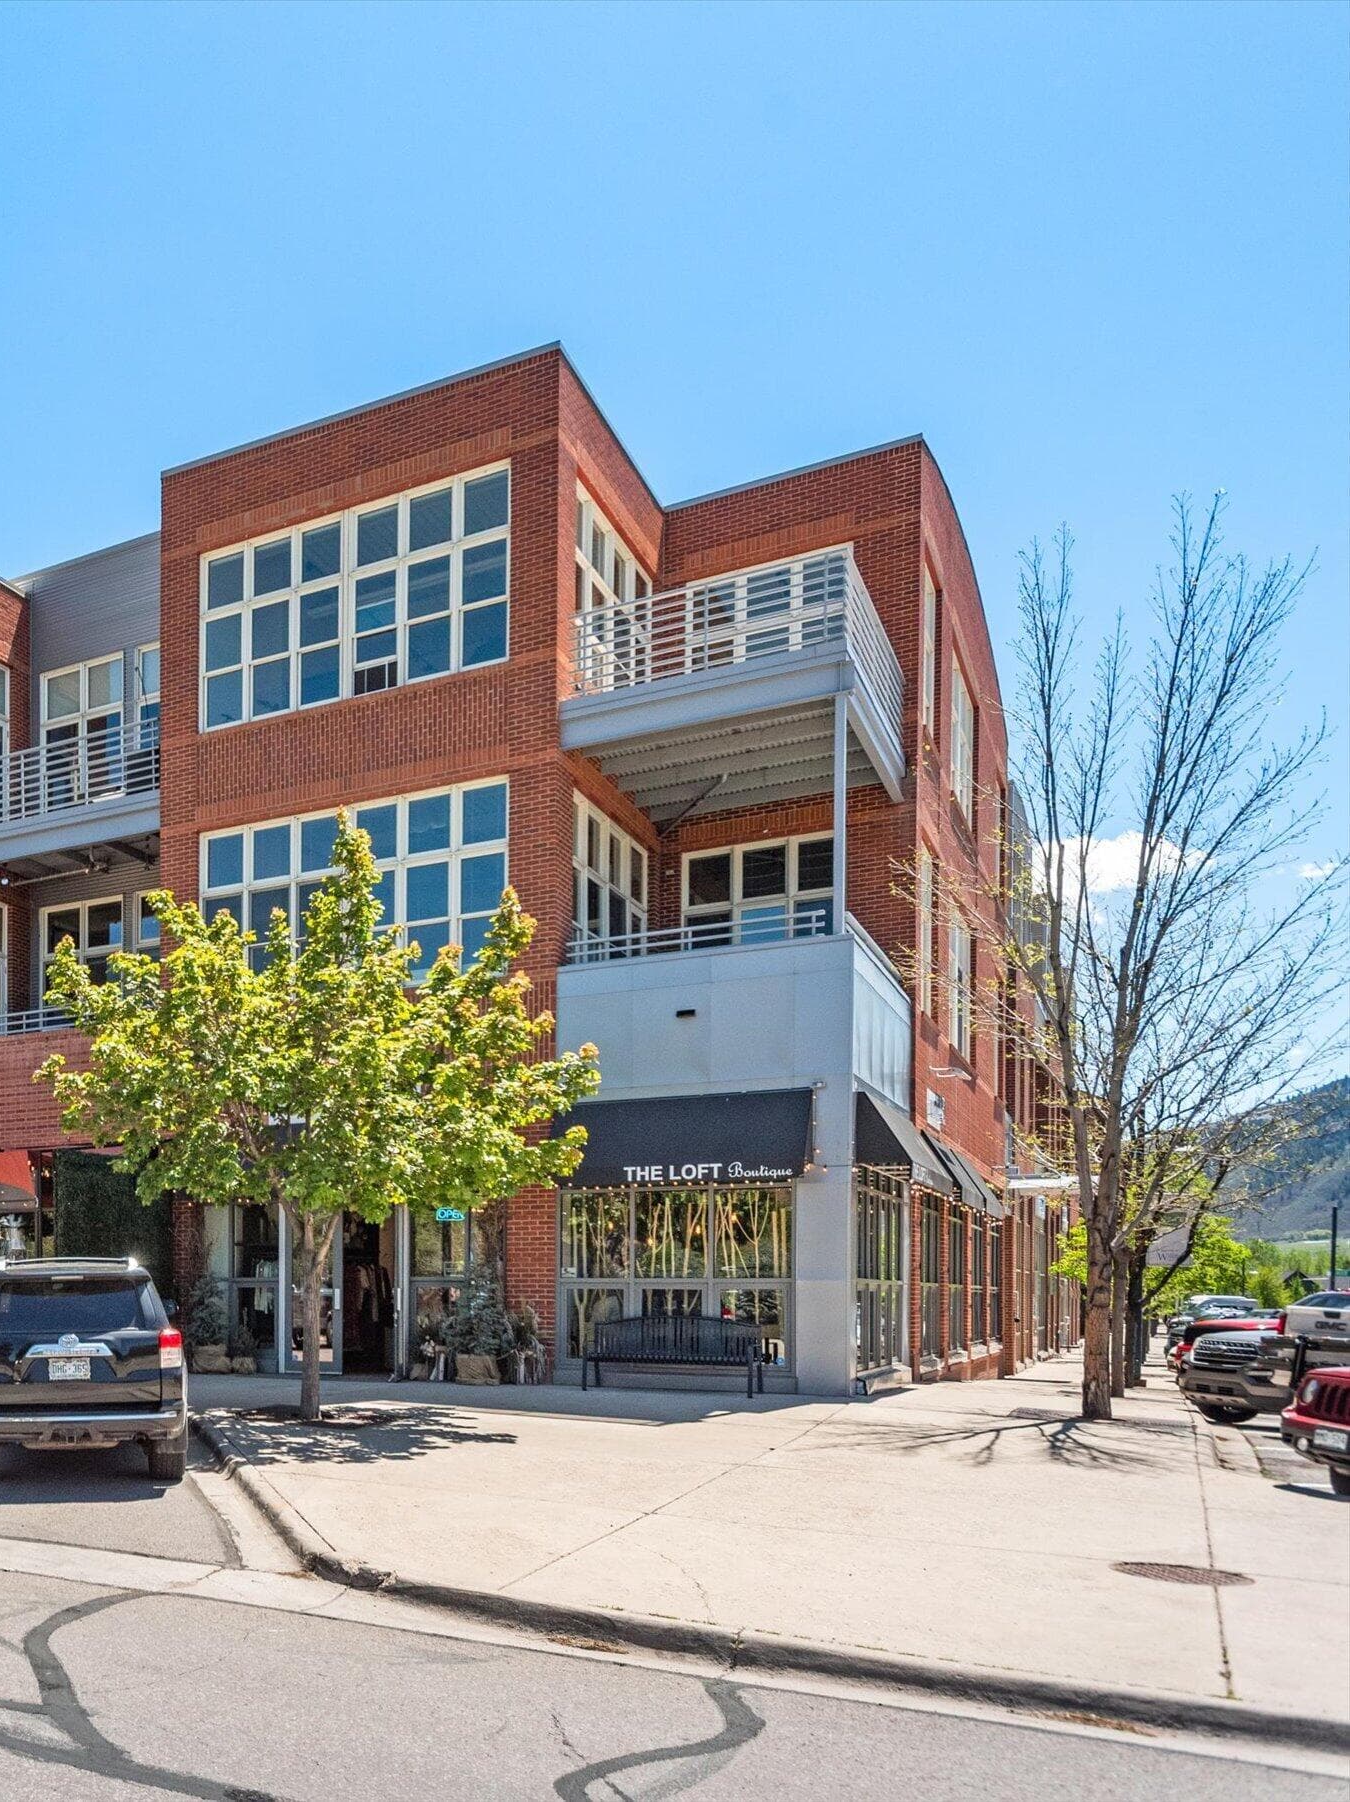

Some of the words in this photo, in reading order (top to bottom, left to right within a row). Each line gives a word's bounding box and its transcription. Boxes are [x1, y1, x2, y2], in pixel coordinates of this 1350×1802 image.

[623, 1165, 663, 1182] THE
[669, 1163, 723, 1181] LOFT
[728, 1161, 793, 1179] Boutique
[1315, 1321, 1347, 1331] GMC
